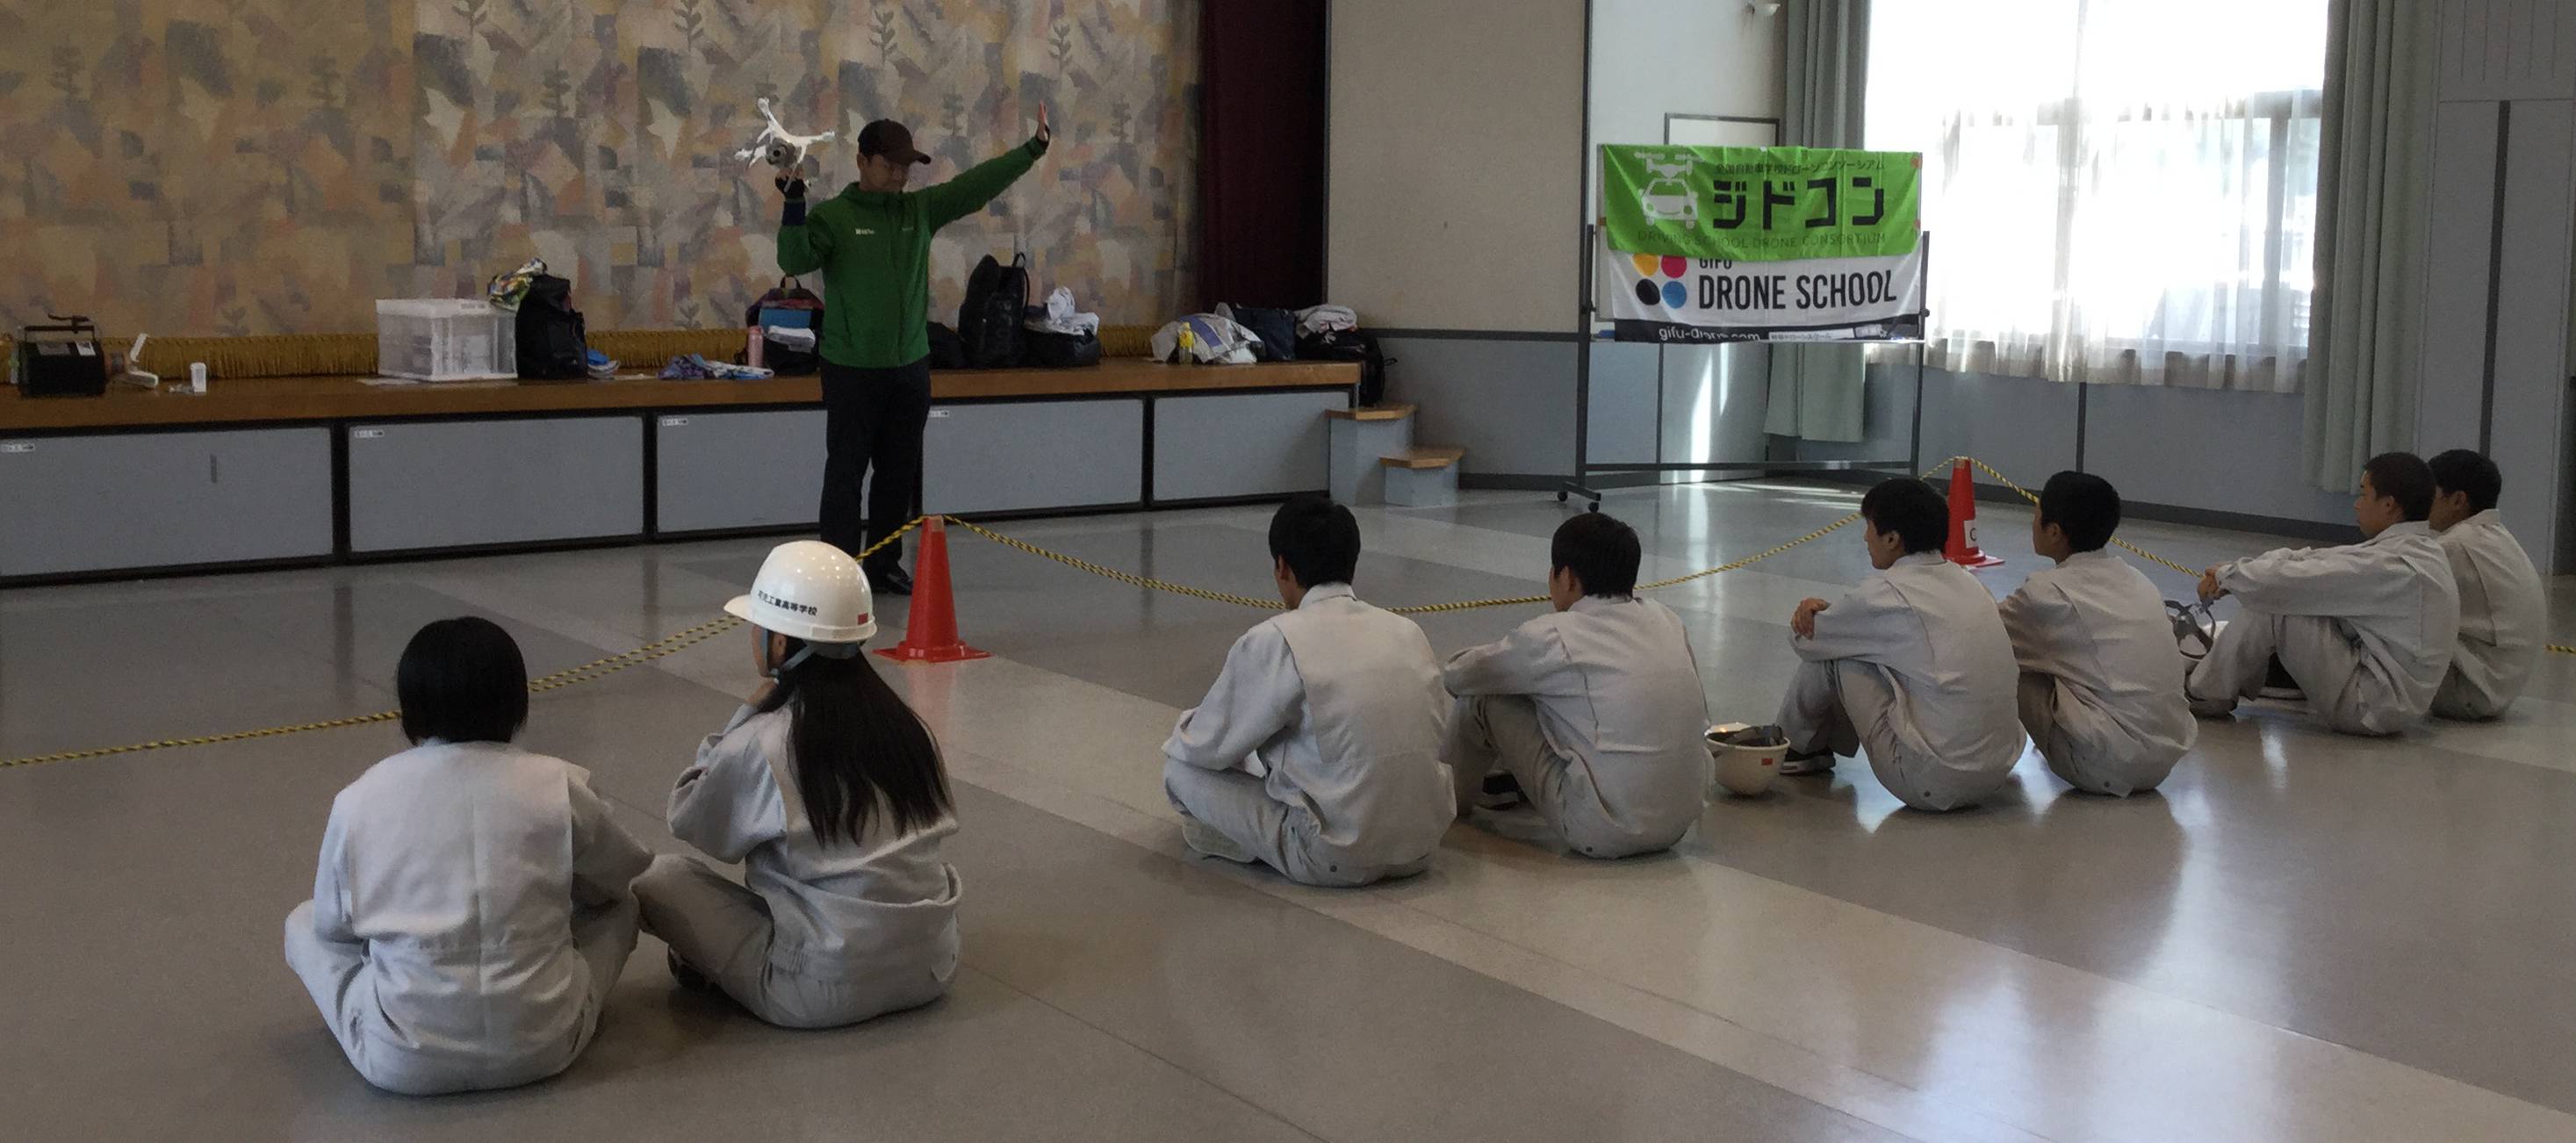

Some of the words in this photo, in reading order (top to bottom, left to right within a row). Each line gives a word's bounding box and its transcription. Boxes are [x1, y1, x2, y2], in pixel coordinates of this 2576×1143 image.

[1713, 177, 1884, 230] ジドコン
[1752, 237, 1797, 249] DRONE
[1802, 233, 1885, 247] CONSORTIUM
[1699, 275, 1787, 310] DRONE
[1796, 270, 1896, 309] SCHOOL
